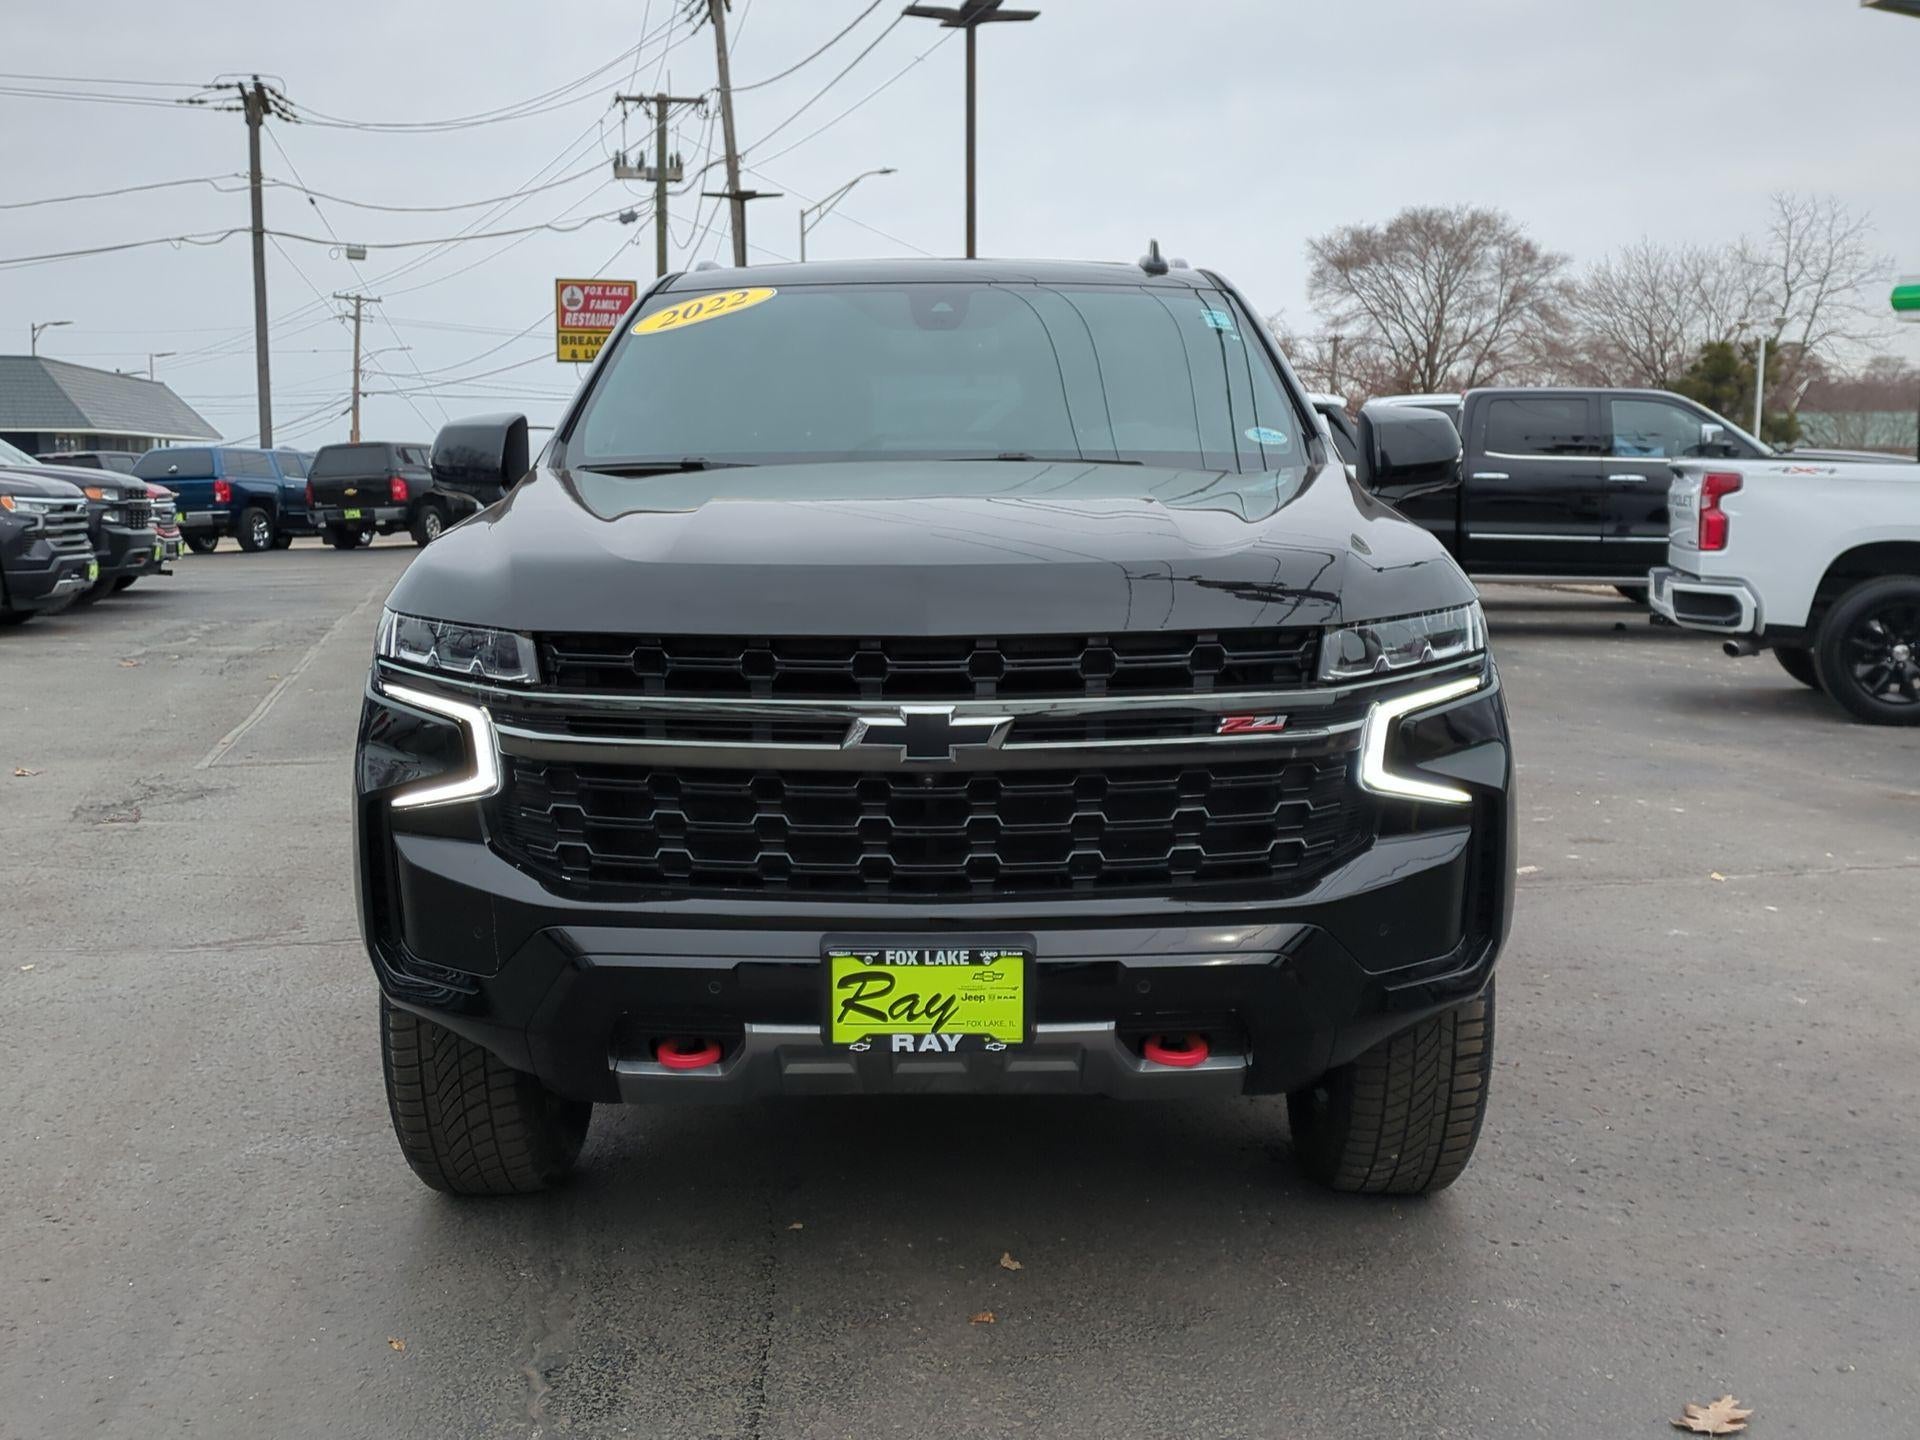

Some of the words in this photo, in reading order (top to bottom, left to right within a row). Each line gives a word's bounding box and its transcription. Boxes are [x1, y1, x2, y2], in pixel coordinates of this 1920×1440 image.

[584, 286, 602, 295] FOX
[605, 286, 629, 296] LAKE
[589, 299, 622, 310] FAMILY
[657, 291, 750, 329] 2022
[885, 950, 918, 965] FOX
[924, 950, 970, 965] LAKE
[836, 970, 960, 1034] Ray
[961, 992, 986, 1003] Jeep
[966, 1020, 983, 1028] FOX
[1009, 1020, 1017, 1028] IL
[892, 1034, 964, 1053] RAY
